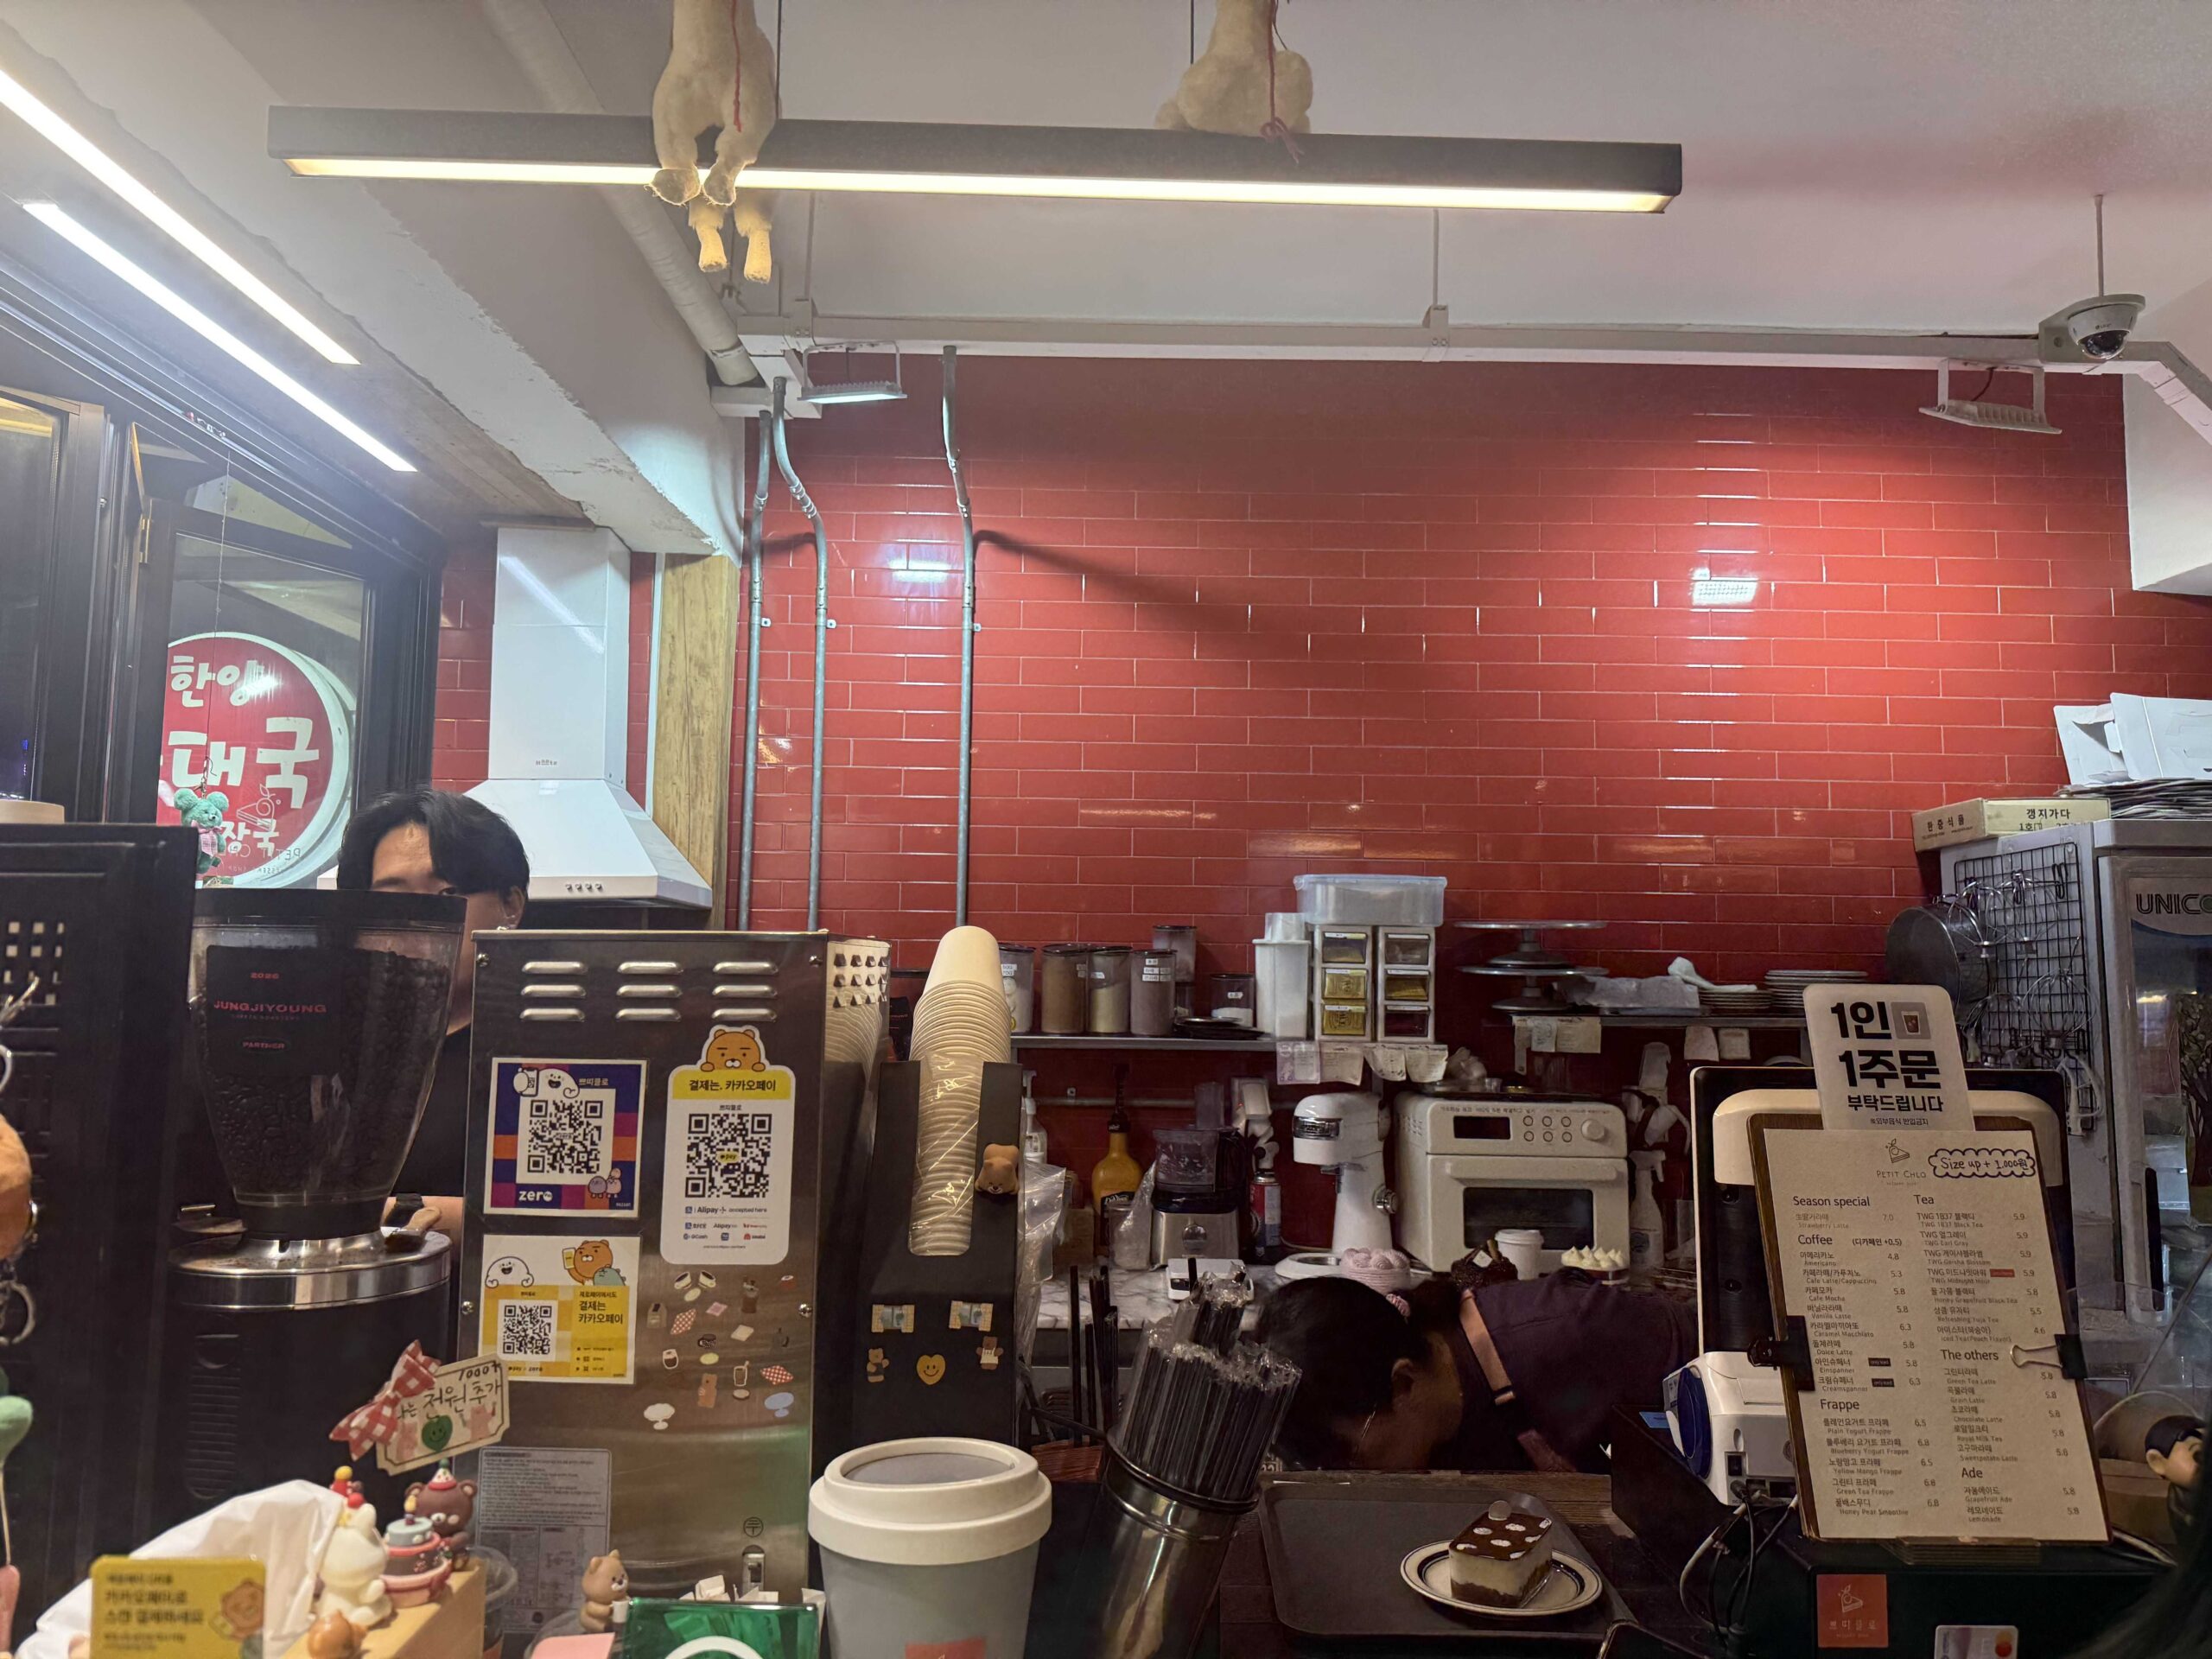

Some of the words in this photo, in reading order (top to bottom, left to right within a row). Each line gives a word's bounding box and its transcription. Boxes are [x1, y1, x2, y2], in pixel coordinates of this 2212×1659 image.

[161, 716, 320, 810] 대국
[2026, 808, 2070, 820] 갱지가다
[213, 1001, 327, 1014] JUNGJIYOUNG
[1830, 1001, 1892, 1039] 1인
[1838, 1049, 1942, 1090] 1주문
[725, 1079, 777, 1091] 카카오페이
[1847, 1095, 1944, 1113] 부탁드립니다
[1941, 1156, 1964, 1169] Size
[1968, 1160, 1981, 1173] up
[1793, 1196, 1831, 1207] Season
[1834, 1196, 1871, 1210] special
[1913, 1194, 1935, 1205] Tea
[1797, 1234, 1833, 1245] Coffee
[579, 1300, 607, 1312] 결제는
[578, 1313, 624, 1325] 카카오페이
[1940, 1349, 1961, 1360] The
[1964, 1350, 1999, 1361] others
[1820, 1399, 1860, 1412] Frappe
[1961, 1467, 1983, 1478] Ade
